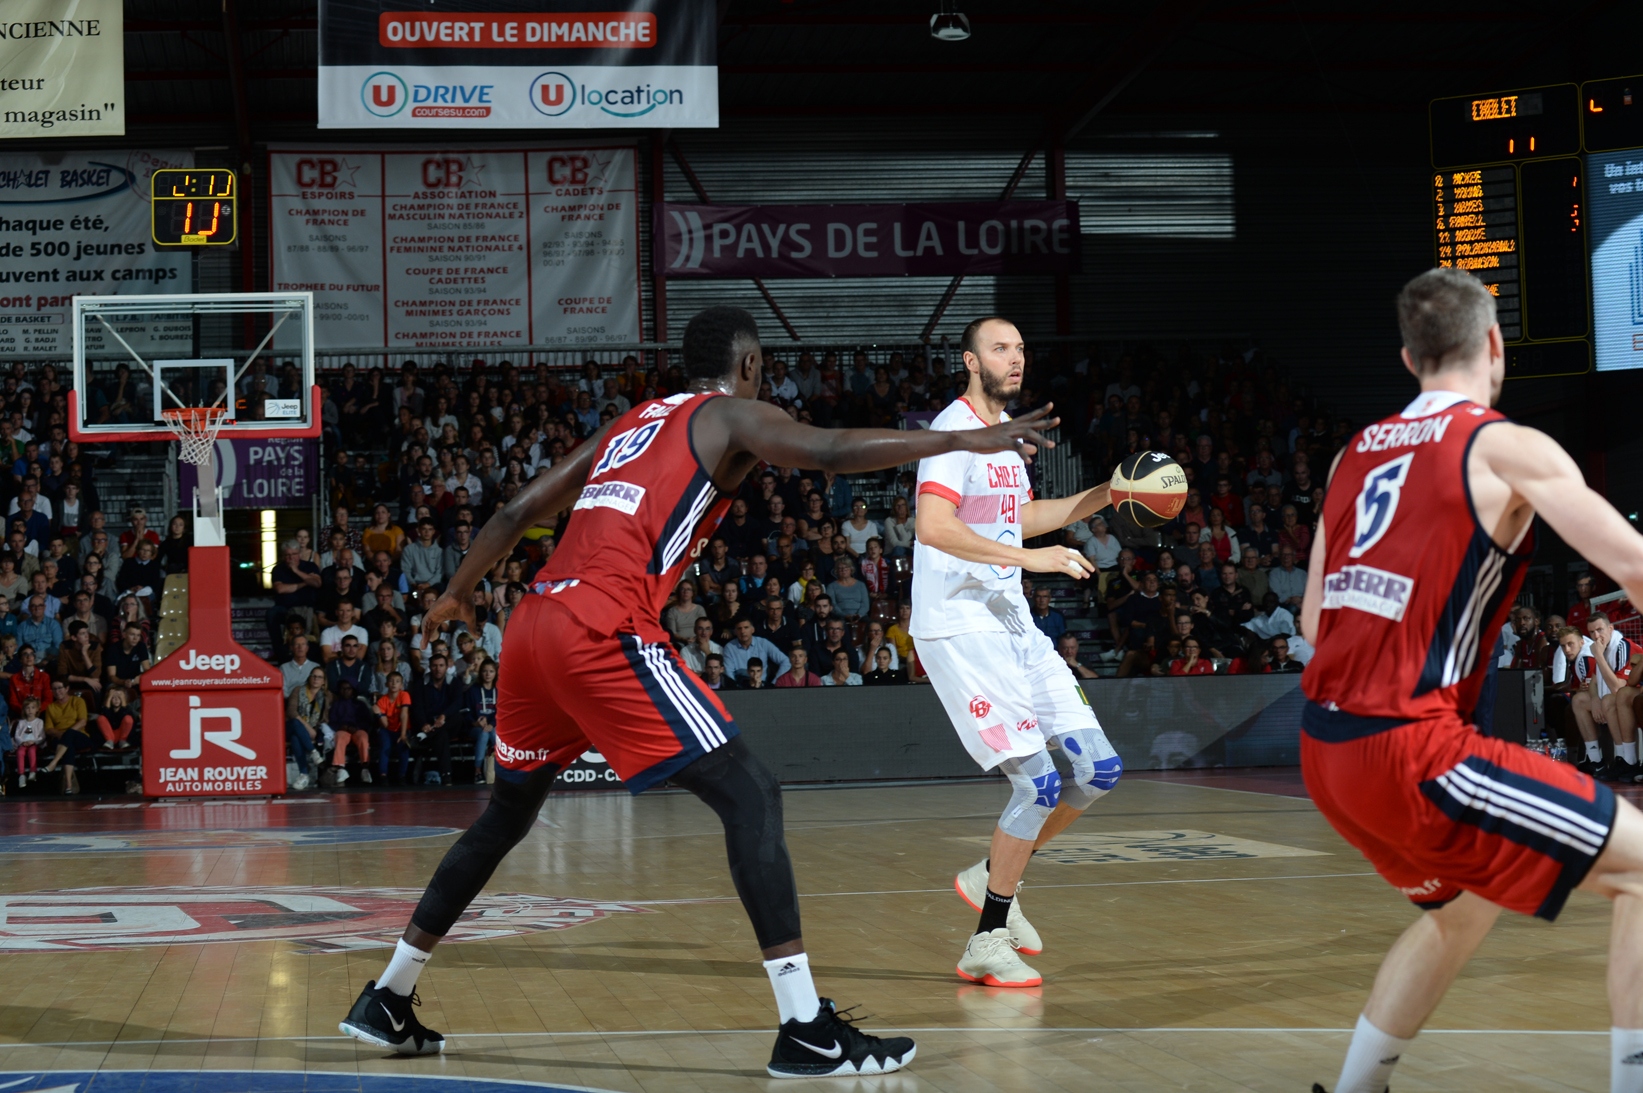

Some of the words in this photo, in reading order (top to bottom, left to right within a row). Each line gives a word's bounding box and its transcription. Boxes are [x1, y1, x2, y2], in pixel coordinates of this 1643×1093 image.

[386, 21, 485, 43] OUVERT
[491, 21, 519, 43] LE
[525, 20, 651, 43] DIMANCHE
[0, 78, 45, 91] teur
[412, 84, 494, 104] DRIVE
[580, 84, 684, 107] location
[415, 107, 487, 118] coursesu.com
[60, 168, 113, 188] BASKET
[301, 191, 355, 200] ESPOIRS
[412, 190, 497, 200] ASSOCIATION
[555, 188, 604, 197] CADETS
[392, 203, 453, 211] CHAMPION
[457, 202, 471, 211] DE
[474, 202, 519, 210] FRANCE
[543, 204, 604, 213] CHAMPION
[607, 202, 622, 211] DE
[288, 208, 349, 217] CHAMPION
[351, 208, 367, 217] DE
[387, 212, 445, 221] MASCULIN
[448, 211, 515, 220] NATIONALE
[518, 211, 524, 219] 2
[561, 213, 605, 222] FRANCE
[0, 217, 64, 236] haque
[70, 215, 110, 232] été,
[305, 218, 349, 226] FRANCE
[427, 222, 460, 230] SAISON
[308, 234, 347, 242] SAISONS
[393, 235, 454, 244] CHAMPION
[457, 235, 472, 243] DE
[475, 234, 520, 242] FRANCE
[564, 231, 603, 239] SAISONS
[712, 222, 812, 259] PAYS
[827, 222, 878, 258] DE
[893, 221, 944, 257] LA
[957, 218, 1071, 255] LOIRE
[0, 242, 24, 257] de
[30, 241, 70, 257] 500
[73, 240, 146, 260] jeunes
[390, 245, 444, 254] FEMININE
[447, 244, 514, 253] NATIONALE
[517, 244, 523, 252] 4
[428, 254, 462, 262] SAISON
[405, 267, 443, 275] COUPE
[446, 267, 460, 275] DE
[464, 266, 509, 275] FRANCE
[0, 268, 60, 283] uvent
[65, 269, 105, 282] aux
[111, 267, 178, 285] camps
[429, 277, 486, 285] CADETTES
[277, 283, 326, 291] TROPHEE
[346, 284, 380, 292] FUTUR
[428, 287, 462, 295] SAISON
[0, 294, 32, 308] ont
[313, 302, 349, 310] AISONS
[394, 300, 456, 308] CHAMPION
[459, 299, 474, 307] DE
[476, 298, 522, 306] FRANCE
[557, 297, 594, 306] COUPE
[597, 296, 612, 305] DE
[405, 309, 453, 317] MINIMES
[456, 308, 511, 317] GARÇONS
[563, 306, 607, 315] FRANCE
[15, 315, 52, 323] BASKET
[429, 319, 463, 327] SAISON
[394, 332, 456, 340] CHAMPION
[460, 331, 474, 339] DE
[477, 331, 522, 339] FRANCE
[566, 326, 606, 335] SAISONS
[1356, 414, 1454, 453] SERRON
[590, 418, 666, 481] 19
[249, 446, 304, 466] PAYS
[280, 466, 293, 475] de
[294, 466, 304, 475] la
[987, 462, 1021, 489] CHOLE
[242, 478, 304, 498] LOIRE
[1000, 494, 1016, 524] 49
[1348, 451, 1415, 558] 5
[179, 649, 241, 674] Jeep
[151, 676, 271, 688] www.jeanrouyerautomobiles.fr
[159, 767, 199, 783] JEAN
[203, 766, 268, 781] ROUYER
[165, 780, 262, 792] AUTOMOBILES
